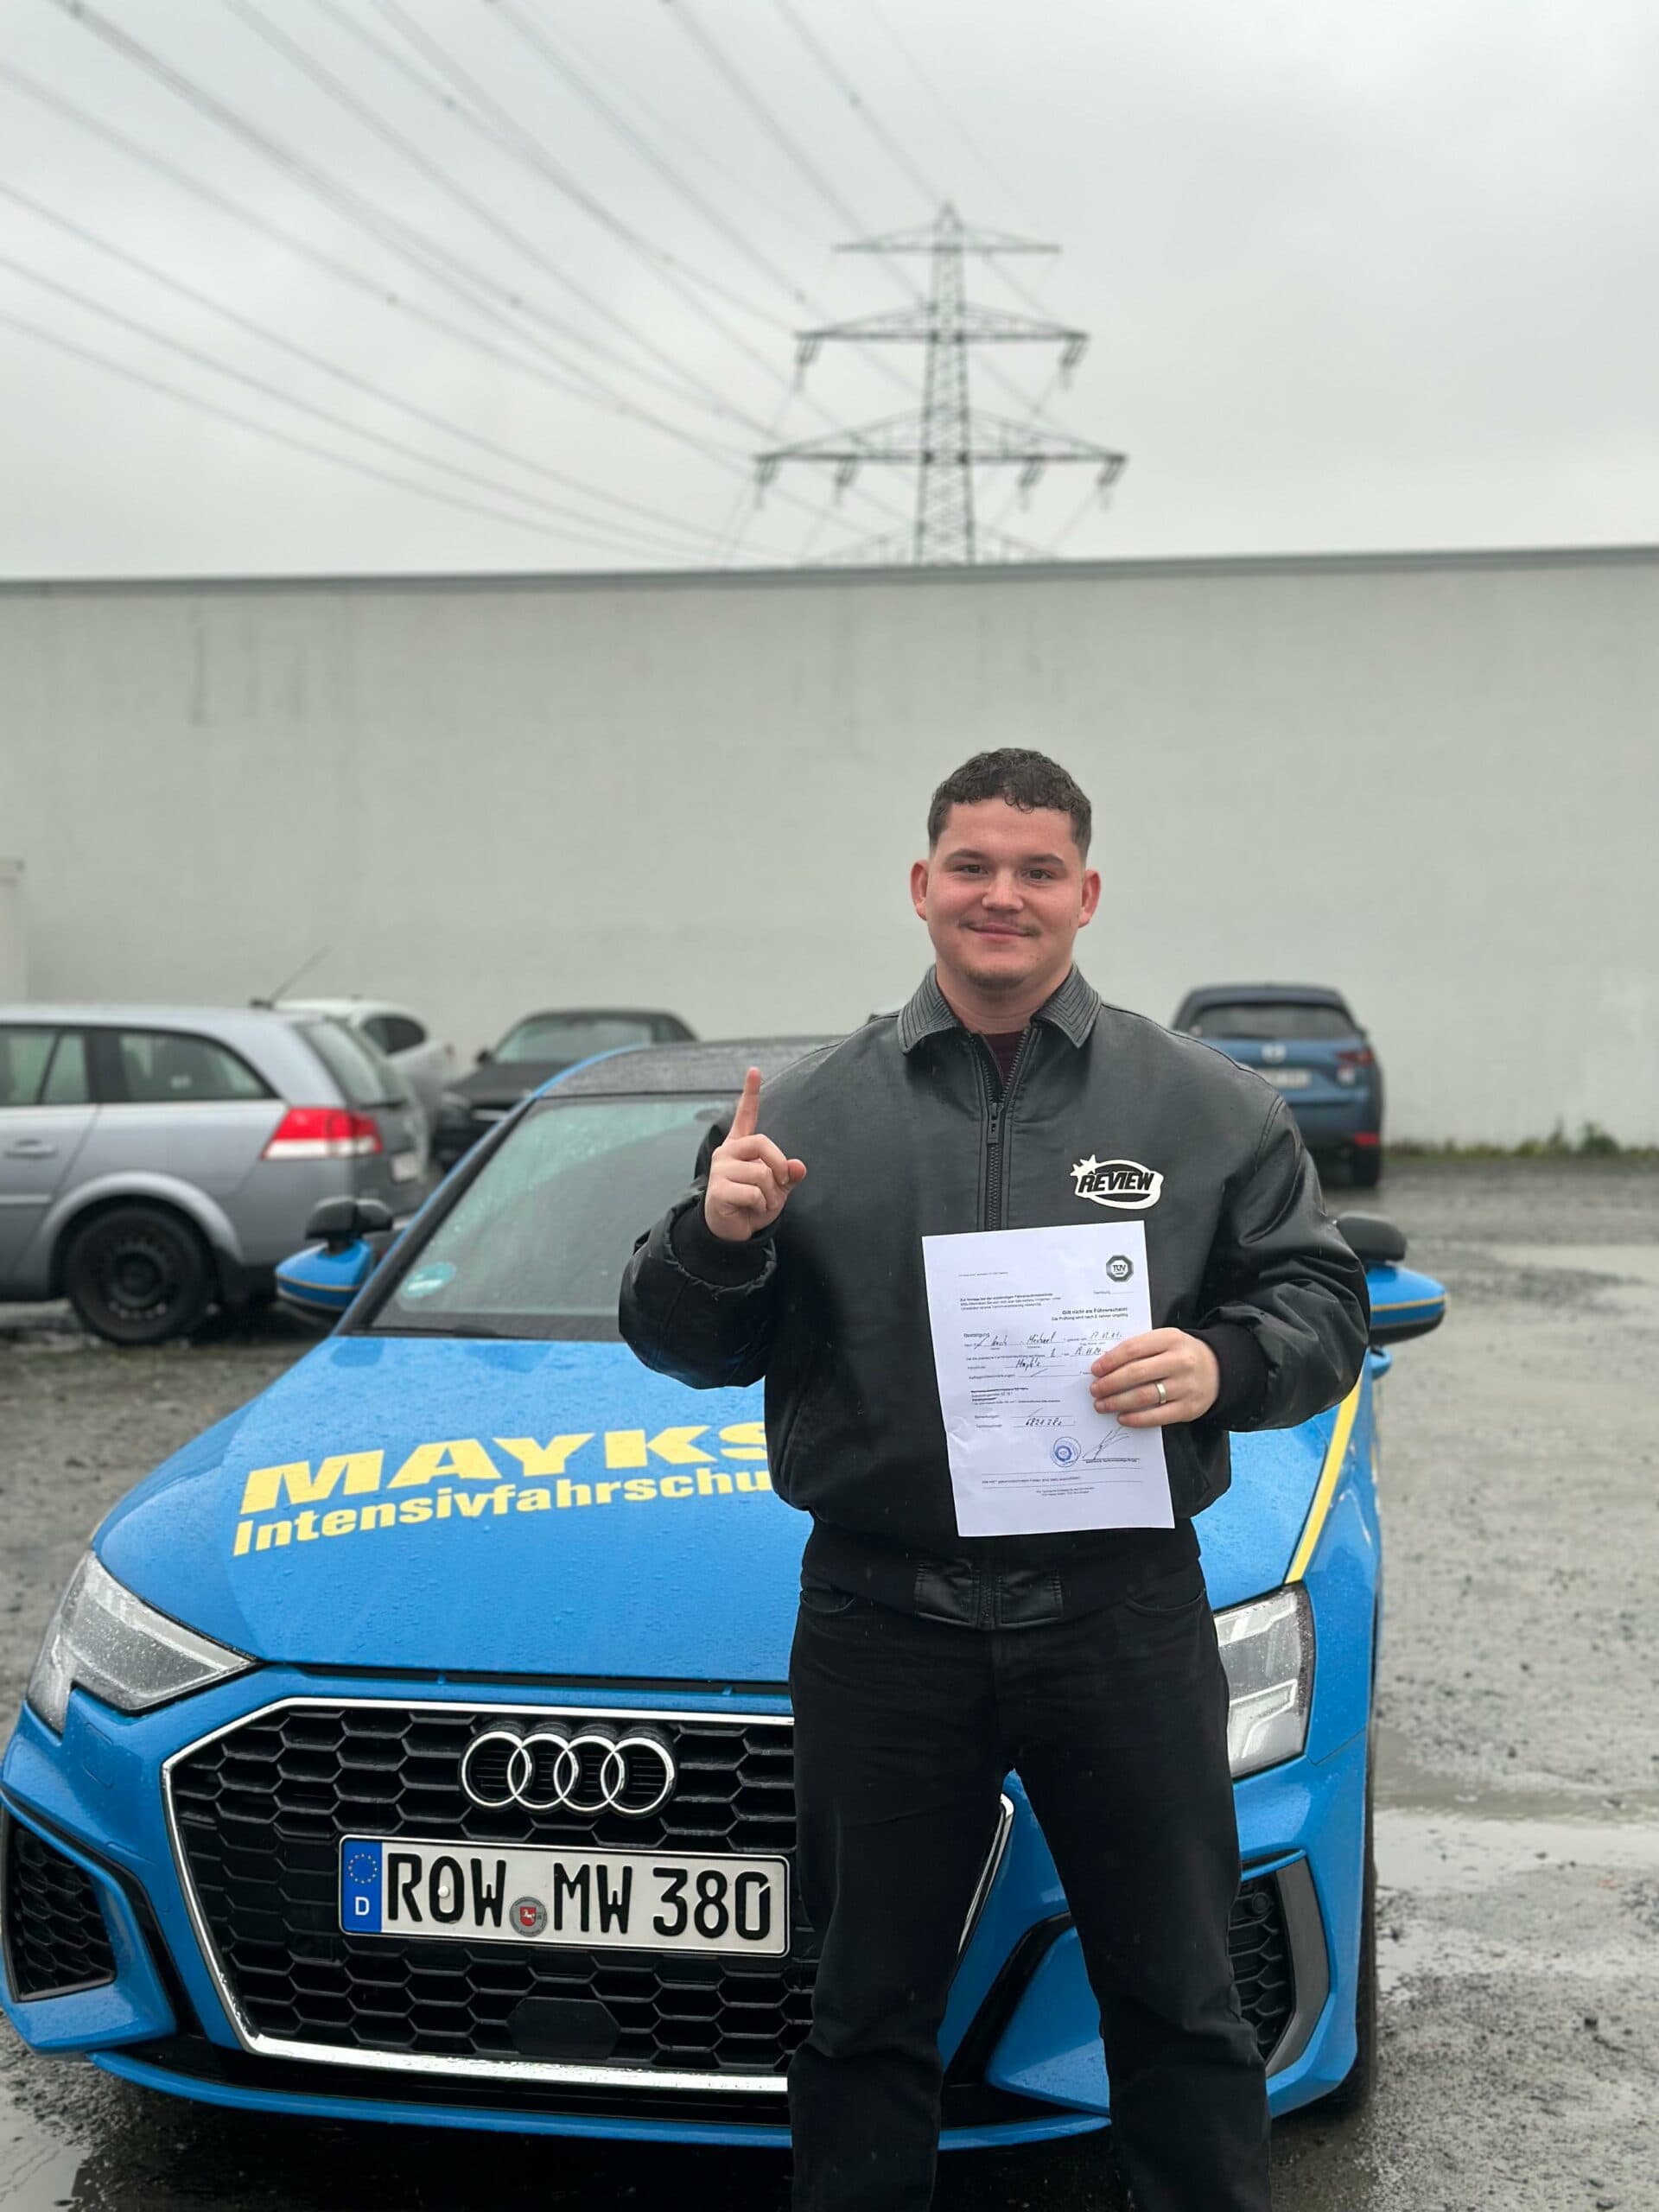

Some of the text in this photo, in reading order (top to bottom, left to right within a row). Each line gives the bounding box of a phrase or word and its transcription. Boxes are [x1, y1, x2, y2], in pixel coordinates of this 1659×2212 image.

[1077, 1172, 1154, 1193] REVIEW
[233, 1467, 772, 1556] Intensivfahrschu
[355, 1896, 370, 1916] D
[387, 1853, 506, 1928] ROW
[553, 1862, 632, 1934] MW
[652, 1867, 771, 1941] 380
